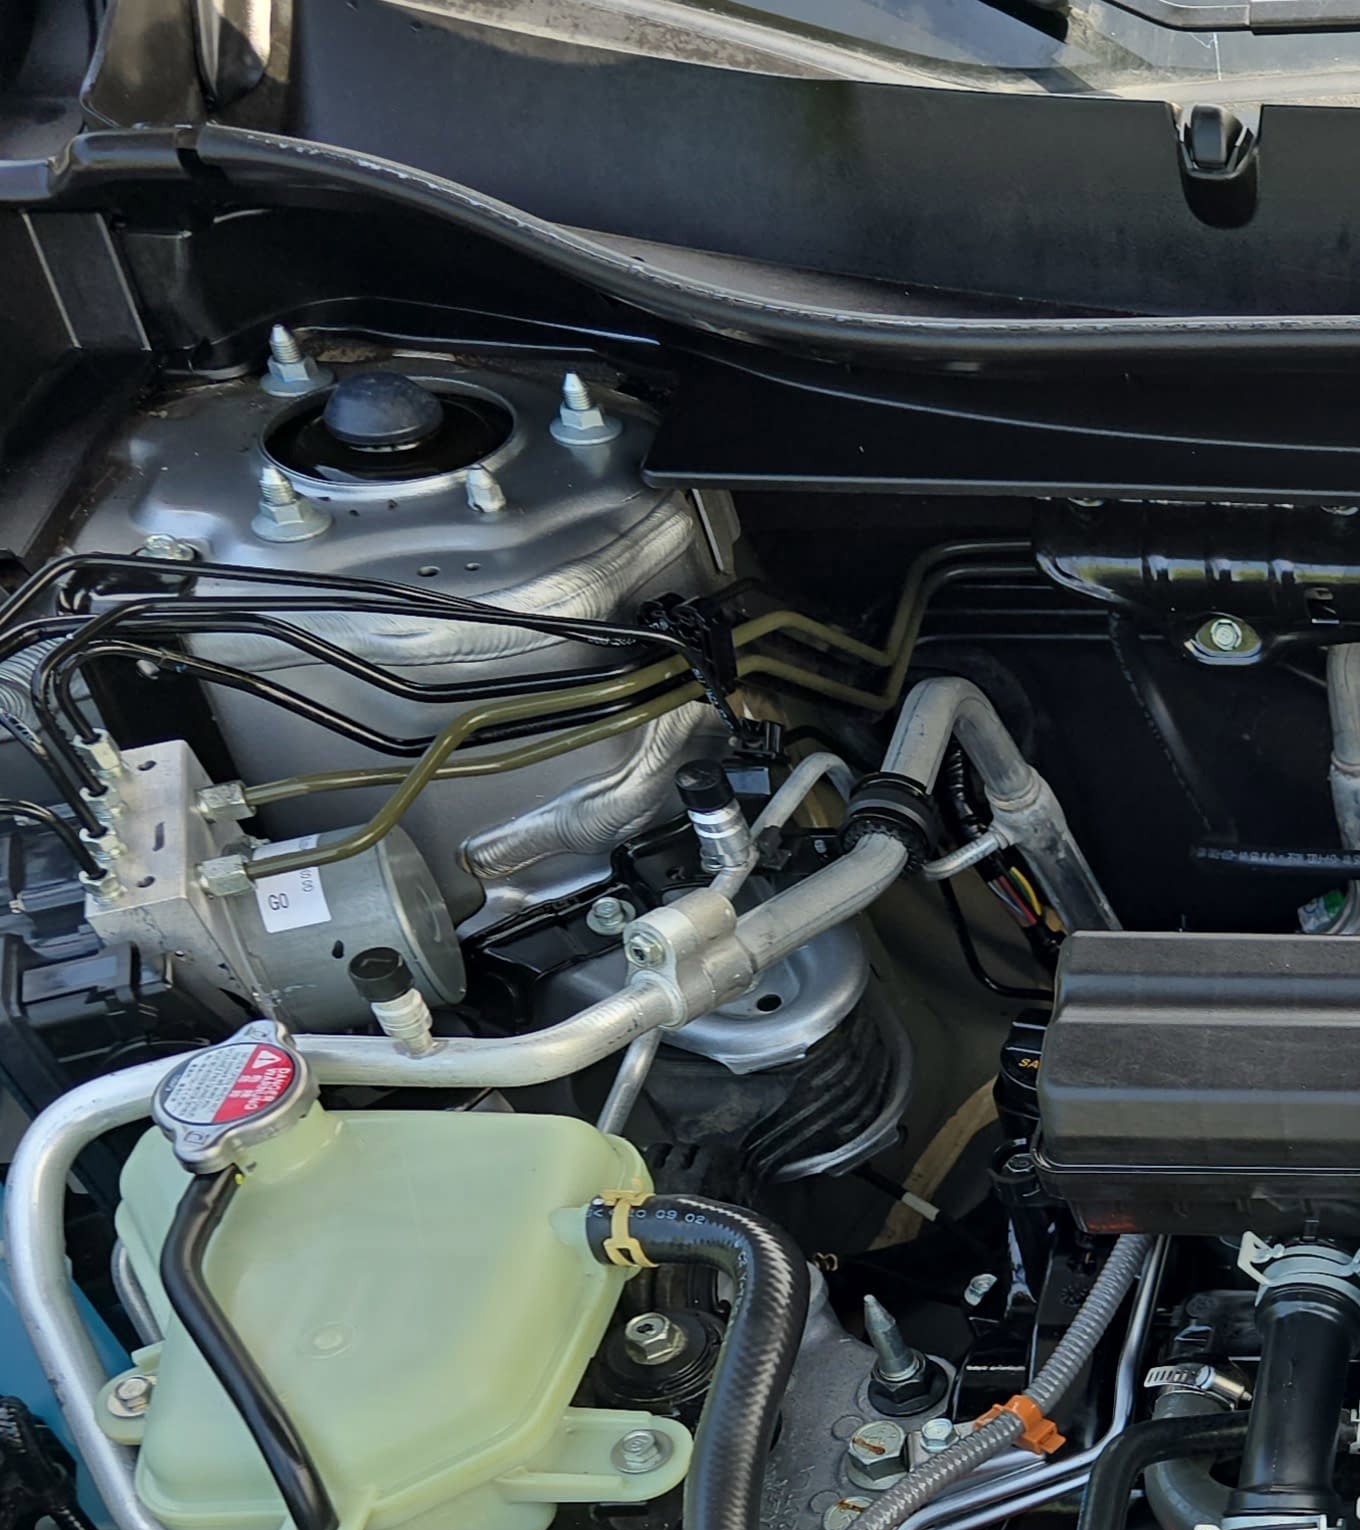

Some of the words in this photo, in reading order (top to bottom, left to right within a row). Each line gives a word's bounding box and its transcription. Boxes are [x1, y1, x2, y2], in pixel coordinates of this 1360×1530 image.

[1018, 1058, 1041, 1069] SA
[243, 1069, 276, 1110] WARNING
[264, 1067, 292, 1102] DANGER
